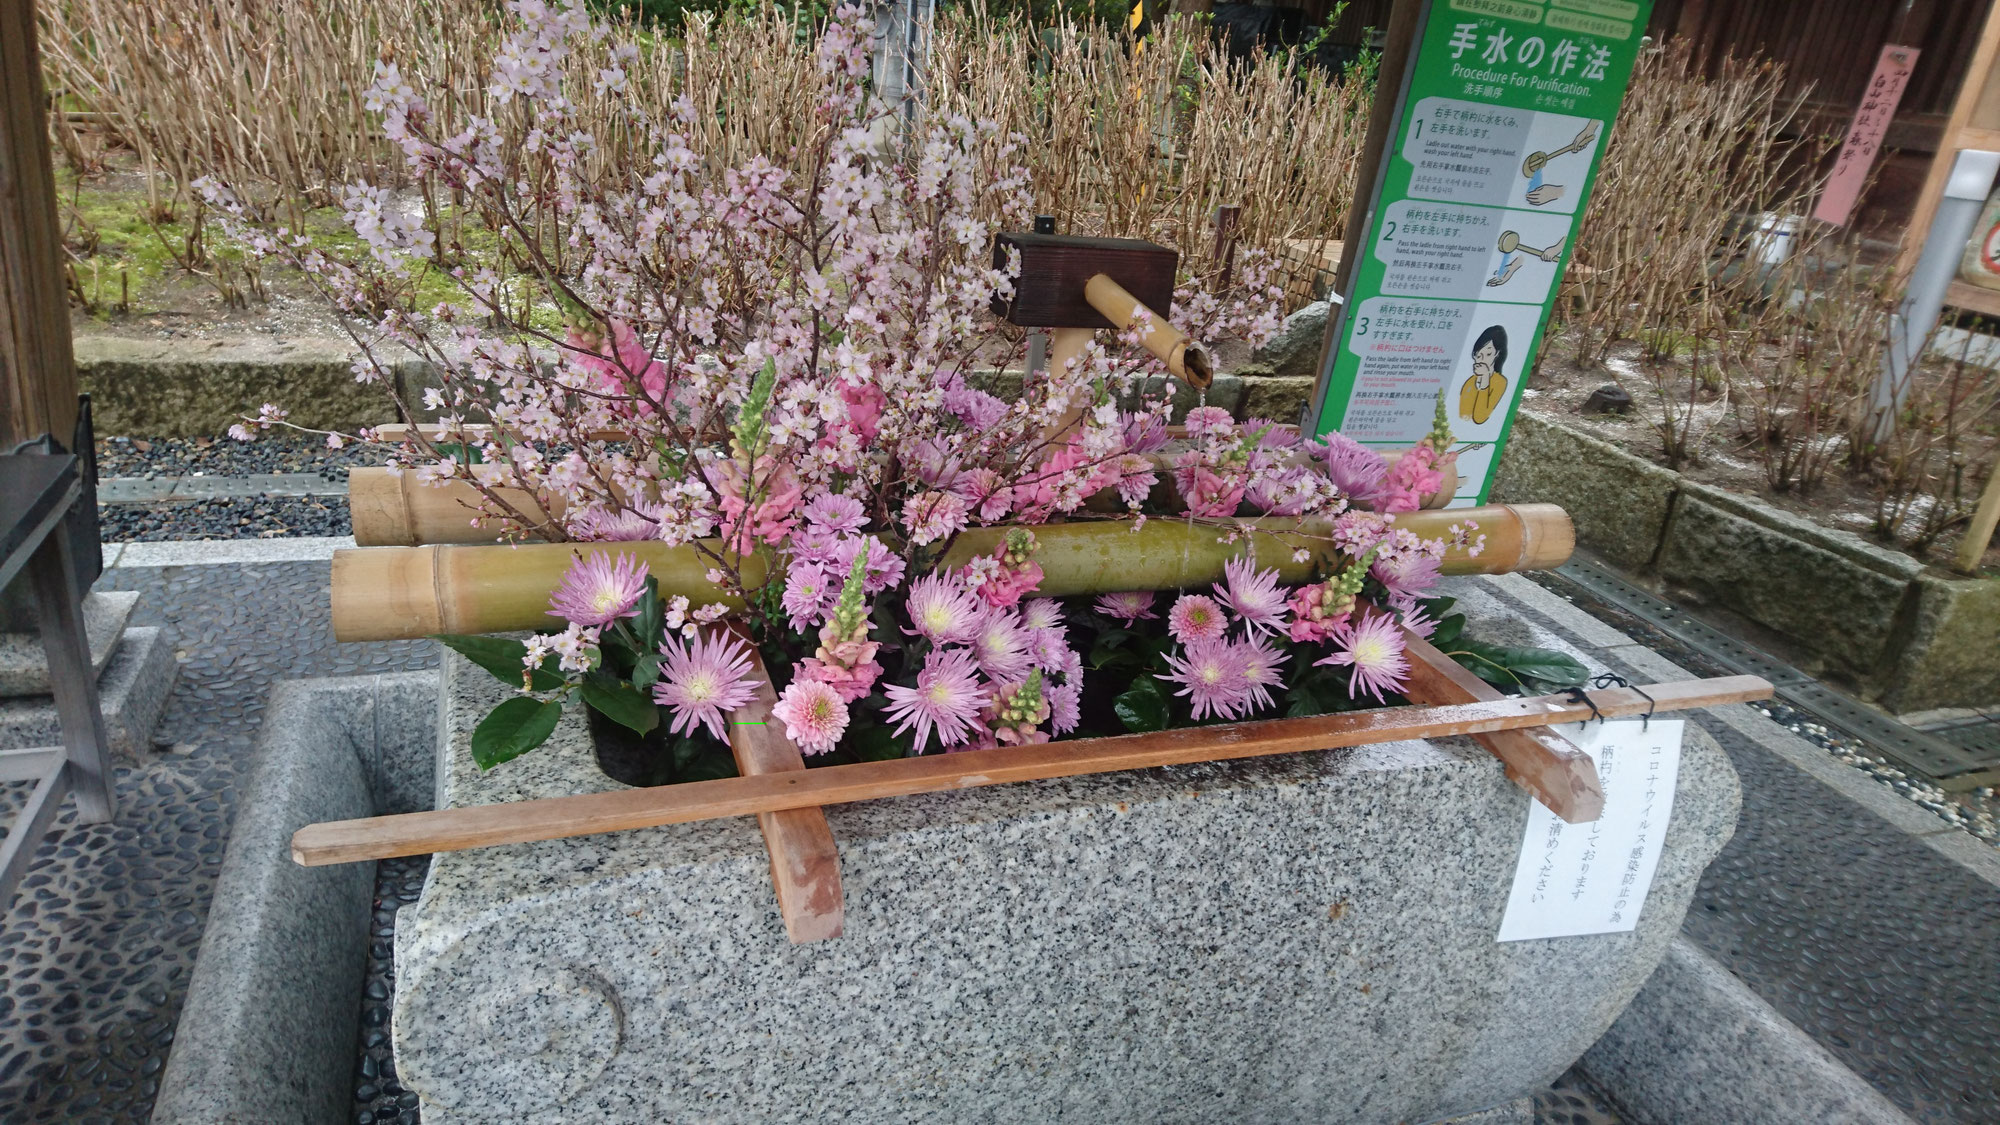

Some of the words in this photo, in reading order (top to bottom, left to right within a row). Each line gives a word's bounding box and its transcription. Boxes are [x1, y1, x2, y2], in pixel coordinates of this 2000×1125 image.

[1448, 23, 1612, 81] 手水の作法
[1452, 63, 1508, 84] Procedure
[1510, 72, 1529, 88] For
[1530, 75, 1592, 97] Purification.
[1415, 119, 1424, 139] 1
[1426, 140, 1440, 148] Ladle
[1383, 221, 1397, 241] 2
[1437, 250, 1450, 258] right
[1445, 243, 1458, 251] right
[1357, 317, 1370, 335] 3
[1375, 318, 1453, 330] 左手に水を受け、口を
[1571, 744, 1615, 901] 柄杓をしております
[1609, 745, 1662, 924] コロナウイルス感染防止の為
